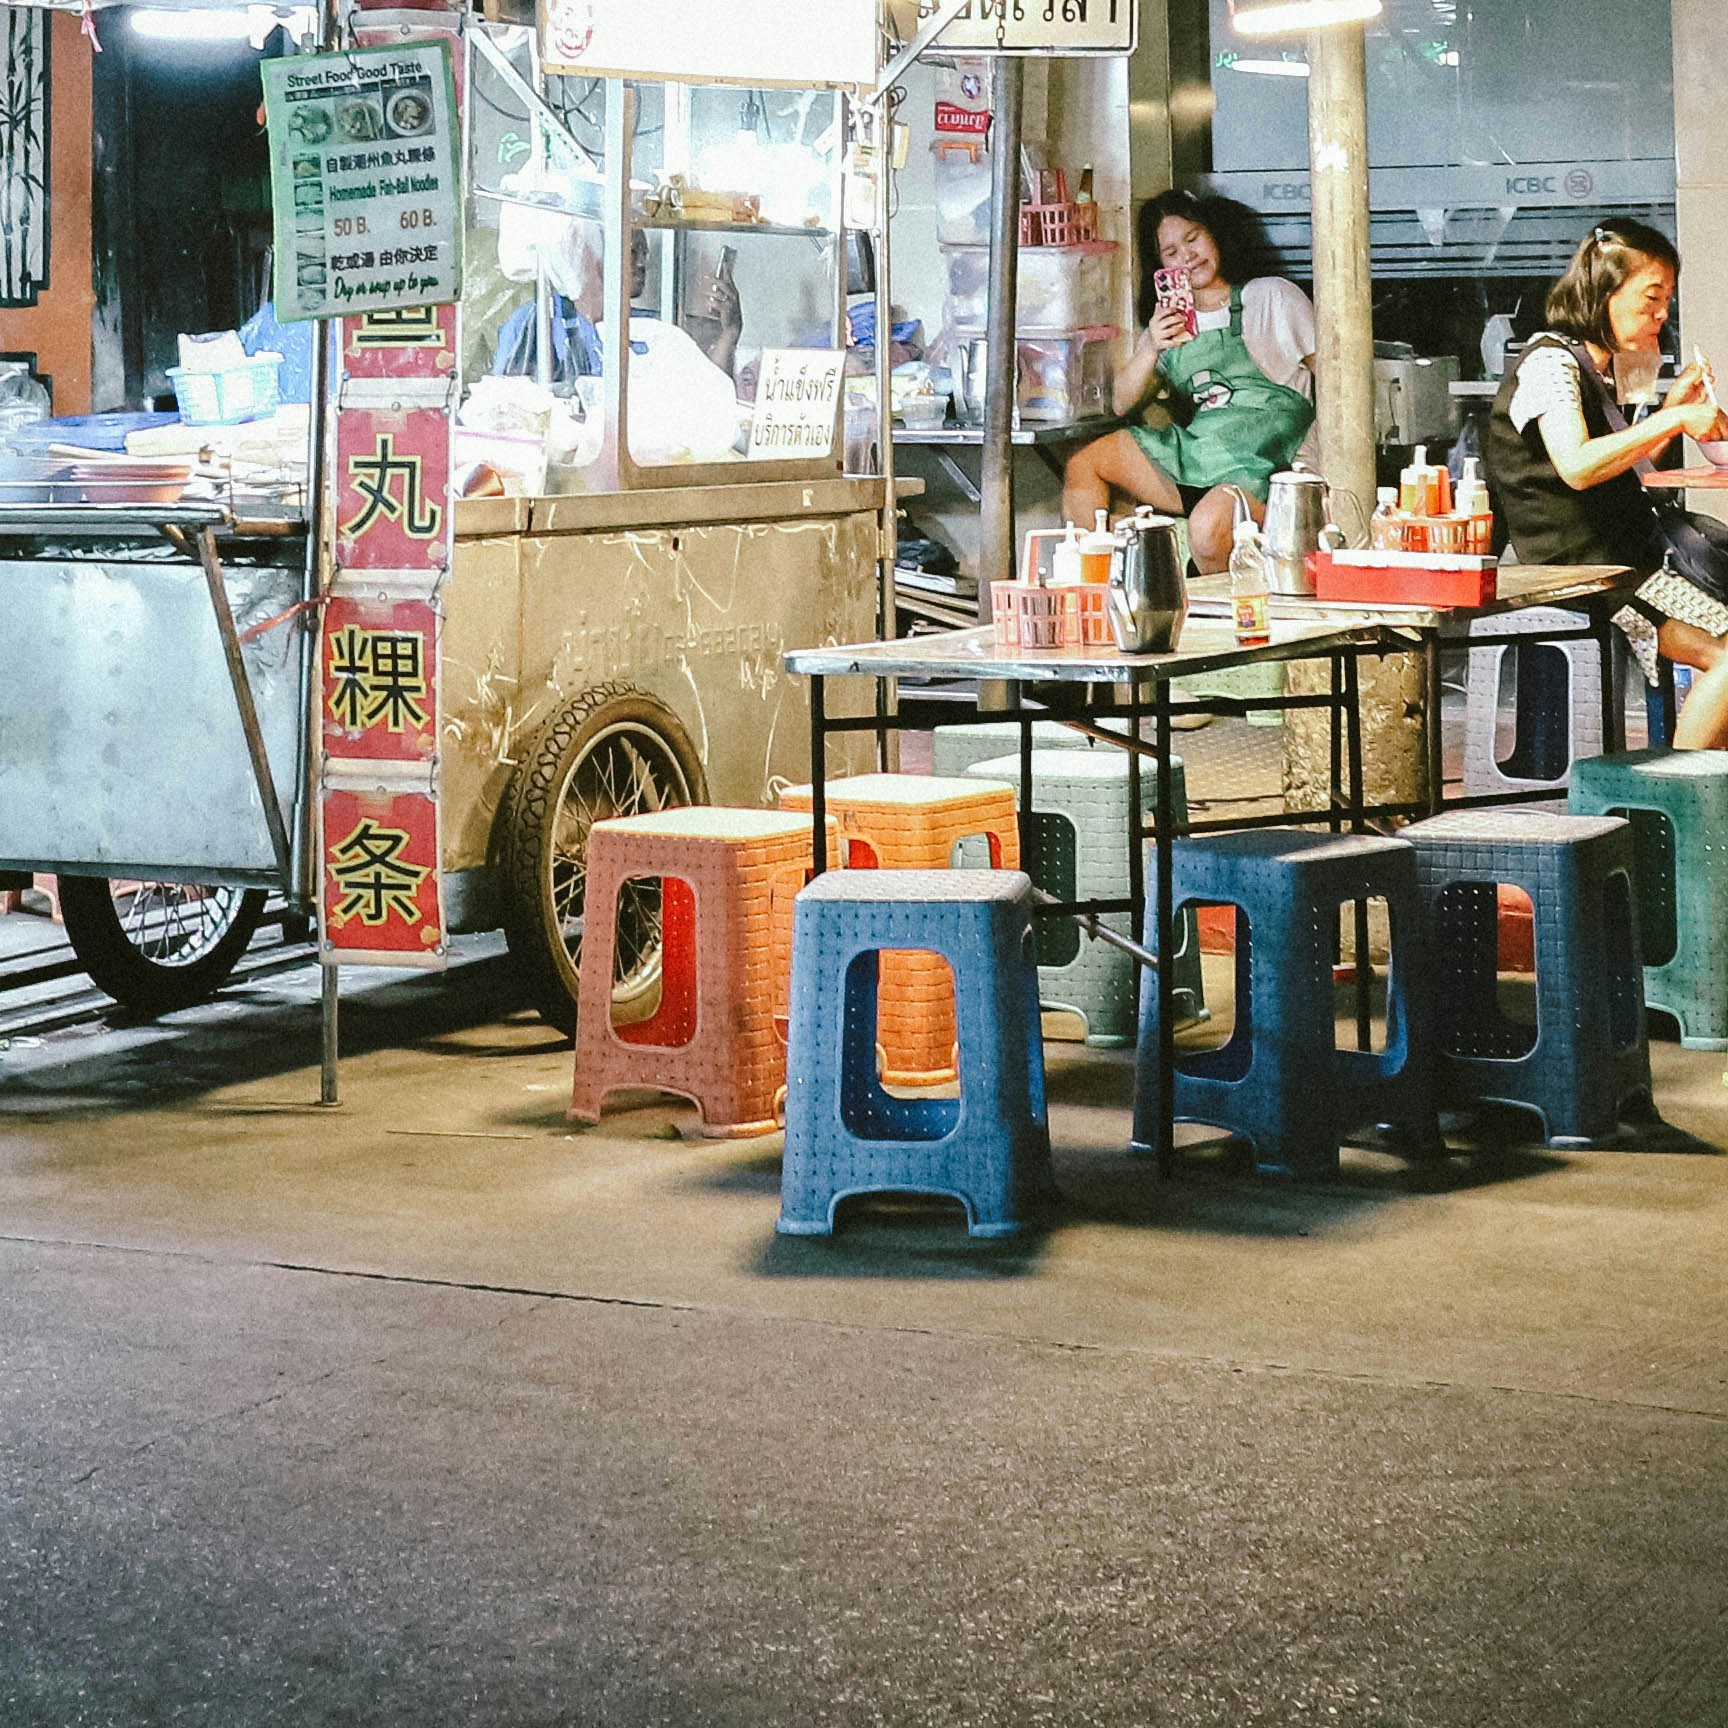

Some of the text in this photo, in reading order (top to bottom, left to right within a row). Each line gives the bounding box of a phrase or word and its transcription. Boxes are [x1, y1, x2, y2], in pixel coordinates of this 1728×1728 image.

[287, 73, 323, 88] Street
[356, 62, 388, 78] Good
[410, 174, 439, 192] Noodles
[1505, 176, 1557, 196] ICBC
[334, 216, 371, 237] 50 B.
[400, 208, 438, 229] 60 B.
[766, 355, 836, 402] น้ำแข็งฟรี
[754, 413, 830, 447] บริการตัวเอง
